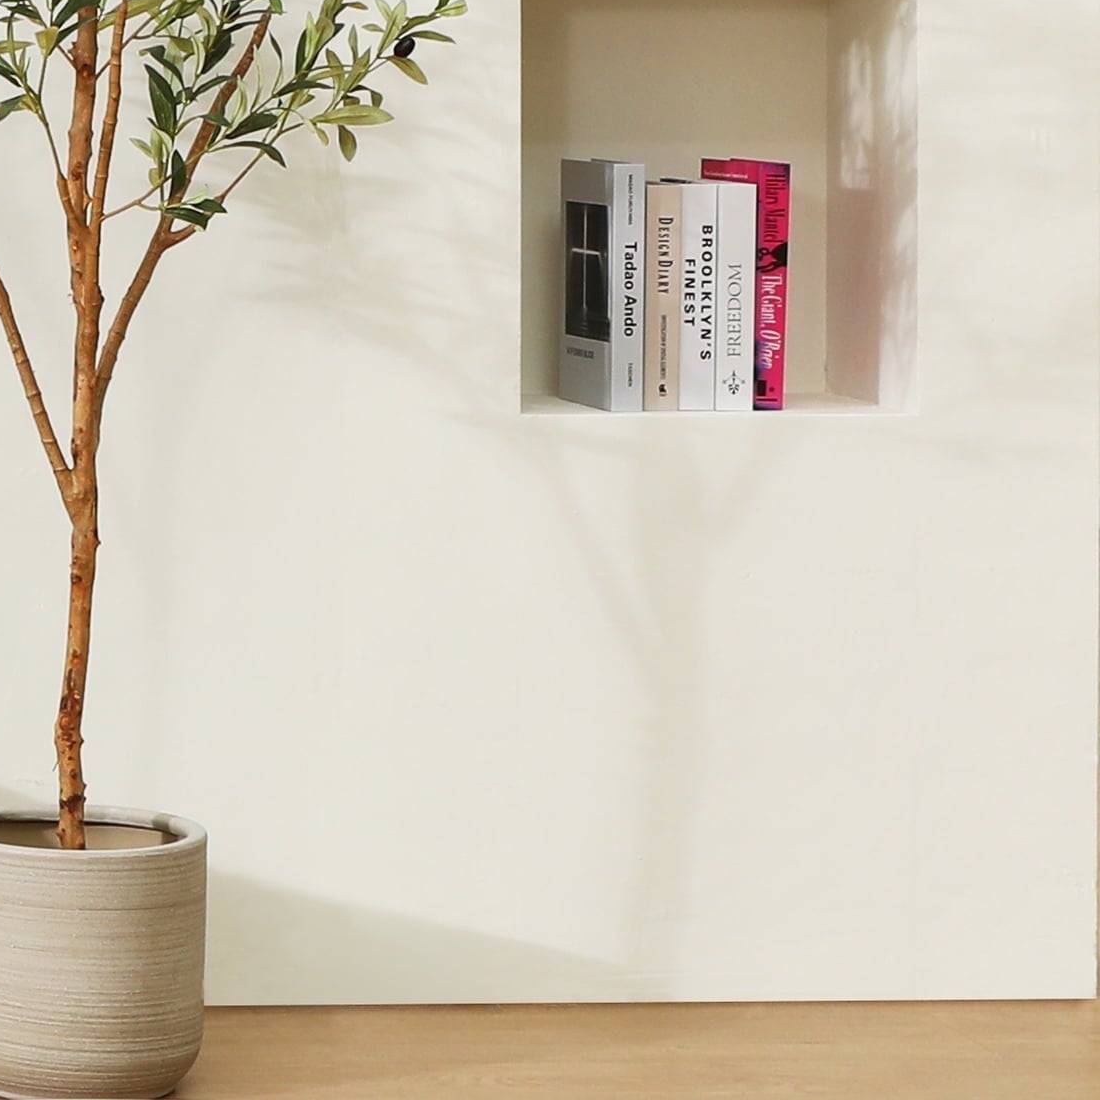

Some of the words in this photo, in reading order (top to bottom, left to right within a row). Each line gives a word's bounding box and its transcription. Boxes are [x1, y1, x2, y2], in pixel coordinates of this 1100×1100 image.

[657, 217, 674, 258] DESIGN
[624, 242, 637, 290] Tadao
[657, 260, 673, 294] DIARY
[761, 274, 782, 295] The
[683, 258, 696, 326] FINEST
[727, 263, 742, 356] FREEDOM
[624, 295, 637, 337] Ando
